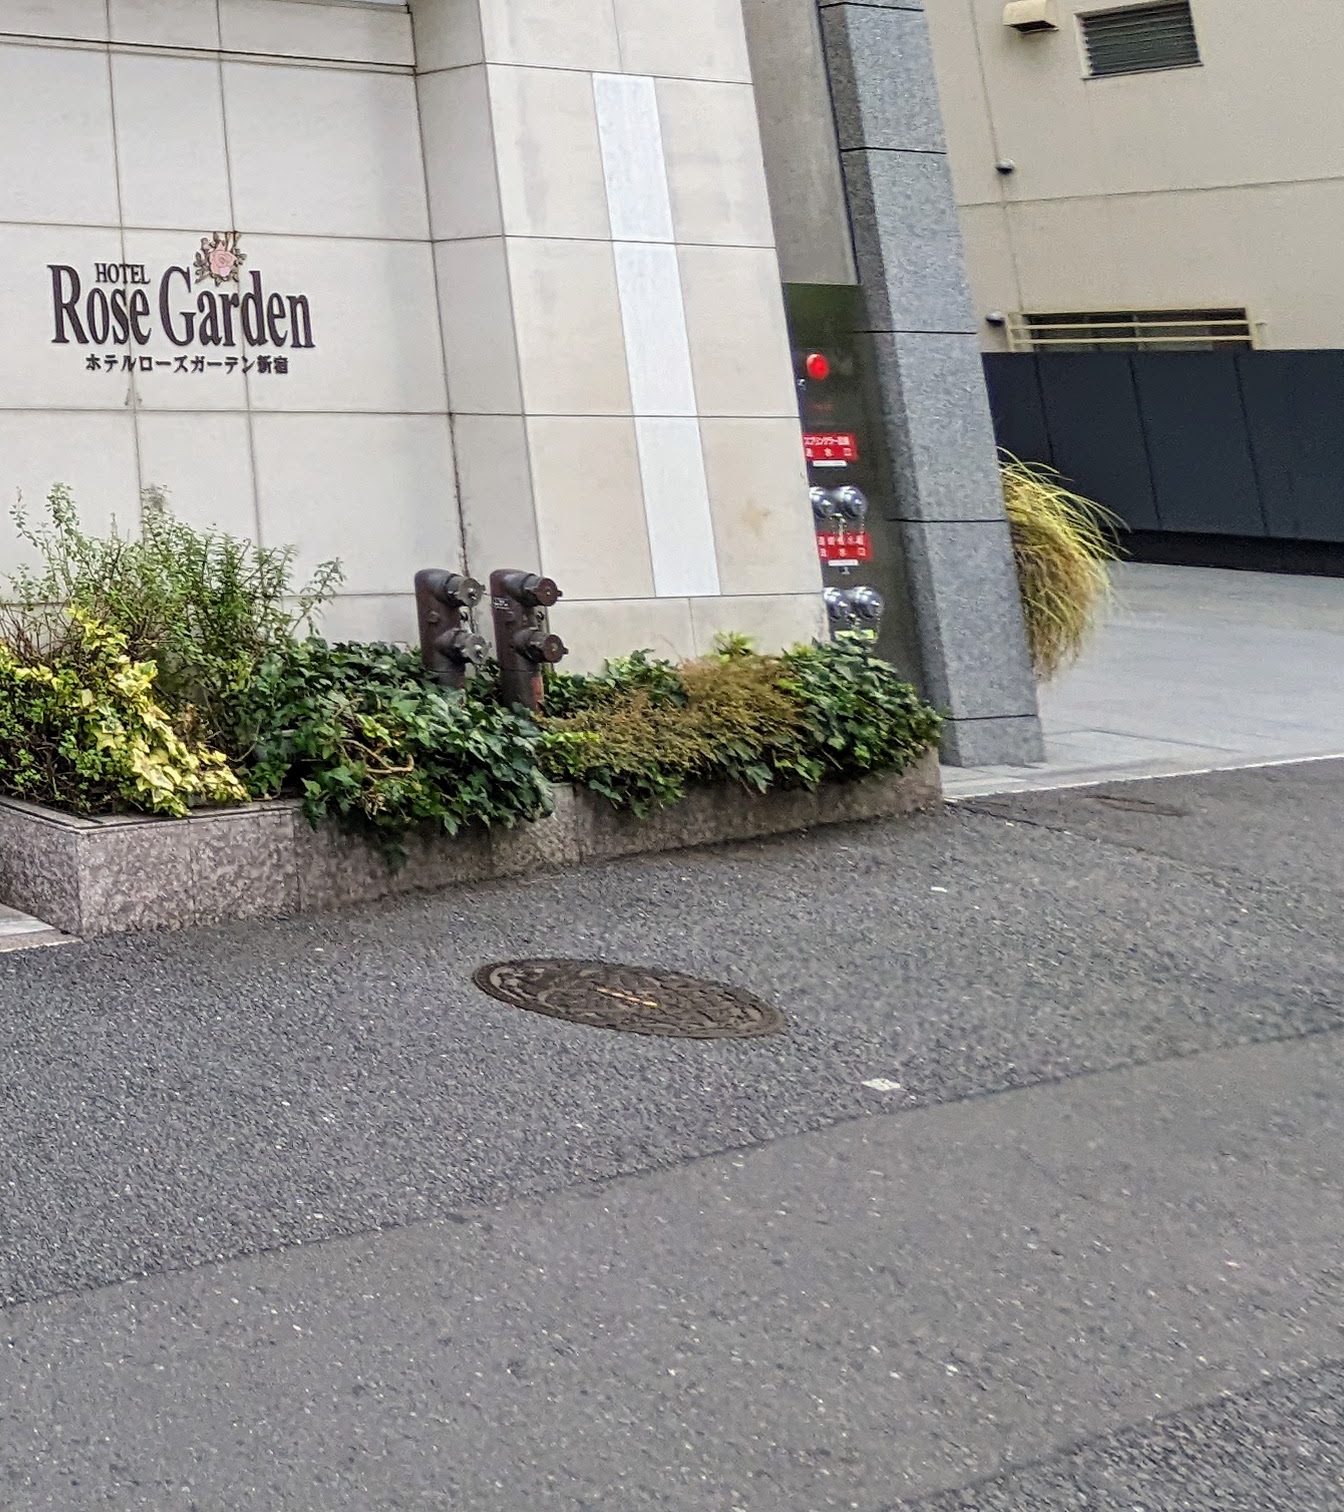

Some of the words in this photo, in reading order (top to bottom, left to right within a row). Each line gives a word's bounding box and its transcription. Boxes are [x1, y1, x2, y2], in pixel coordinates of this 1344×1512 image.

[95, 262, 150, 285] HOTEL
[47, 264, 151, 345] Rose
[159, 266, 315, 348] Garden
[86, 353, 288, 374] ホテルローズガーデン新宿
